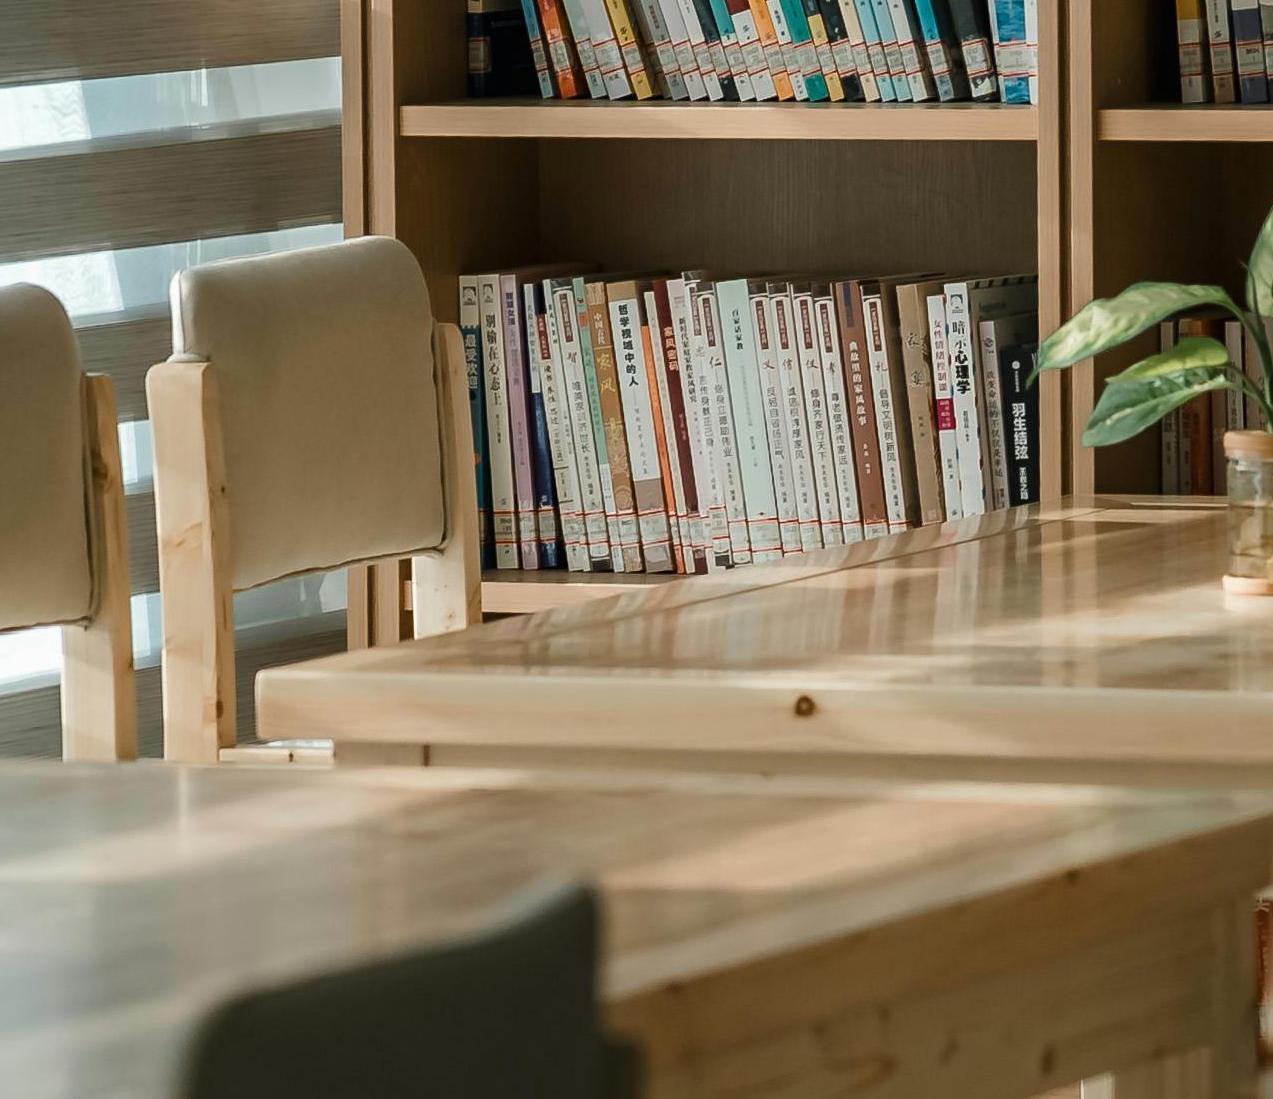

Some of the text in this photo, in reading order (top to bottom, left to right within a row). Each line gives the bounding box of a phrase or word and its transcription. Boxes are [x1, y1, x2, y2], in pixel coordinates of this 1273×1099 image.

[485, 314, 502, 406] 别输在心态上
[619, 304, 639, 387] 哲学视域中的人
[709, 356, 722, 367] 仁
[1011, 401, 1029, 461] 羽生结弦
